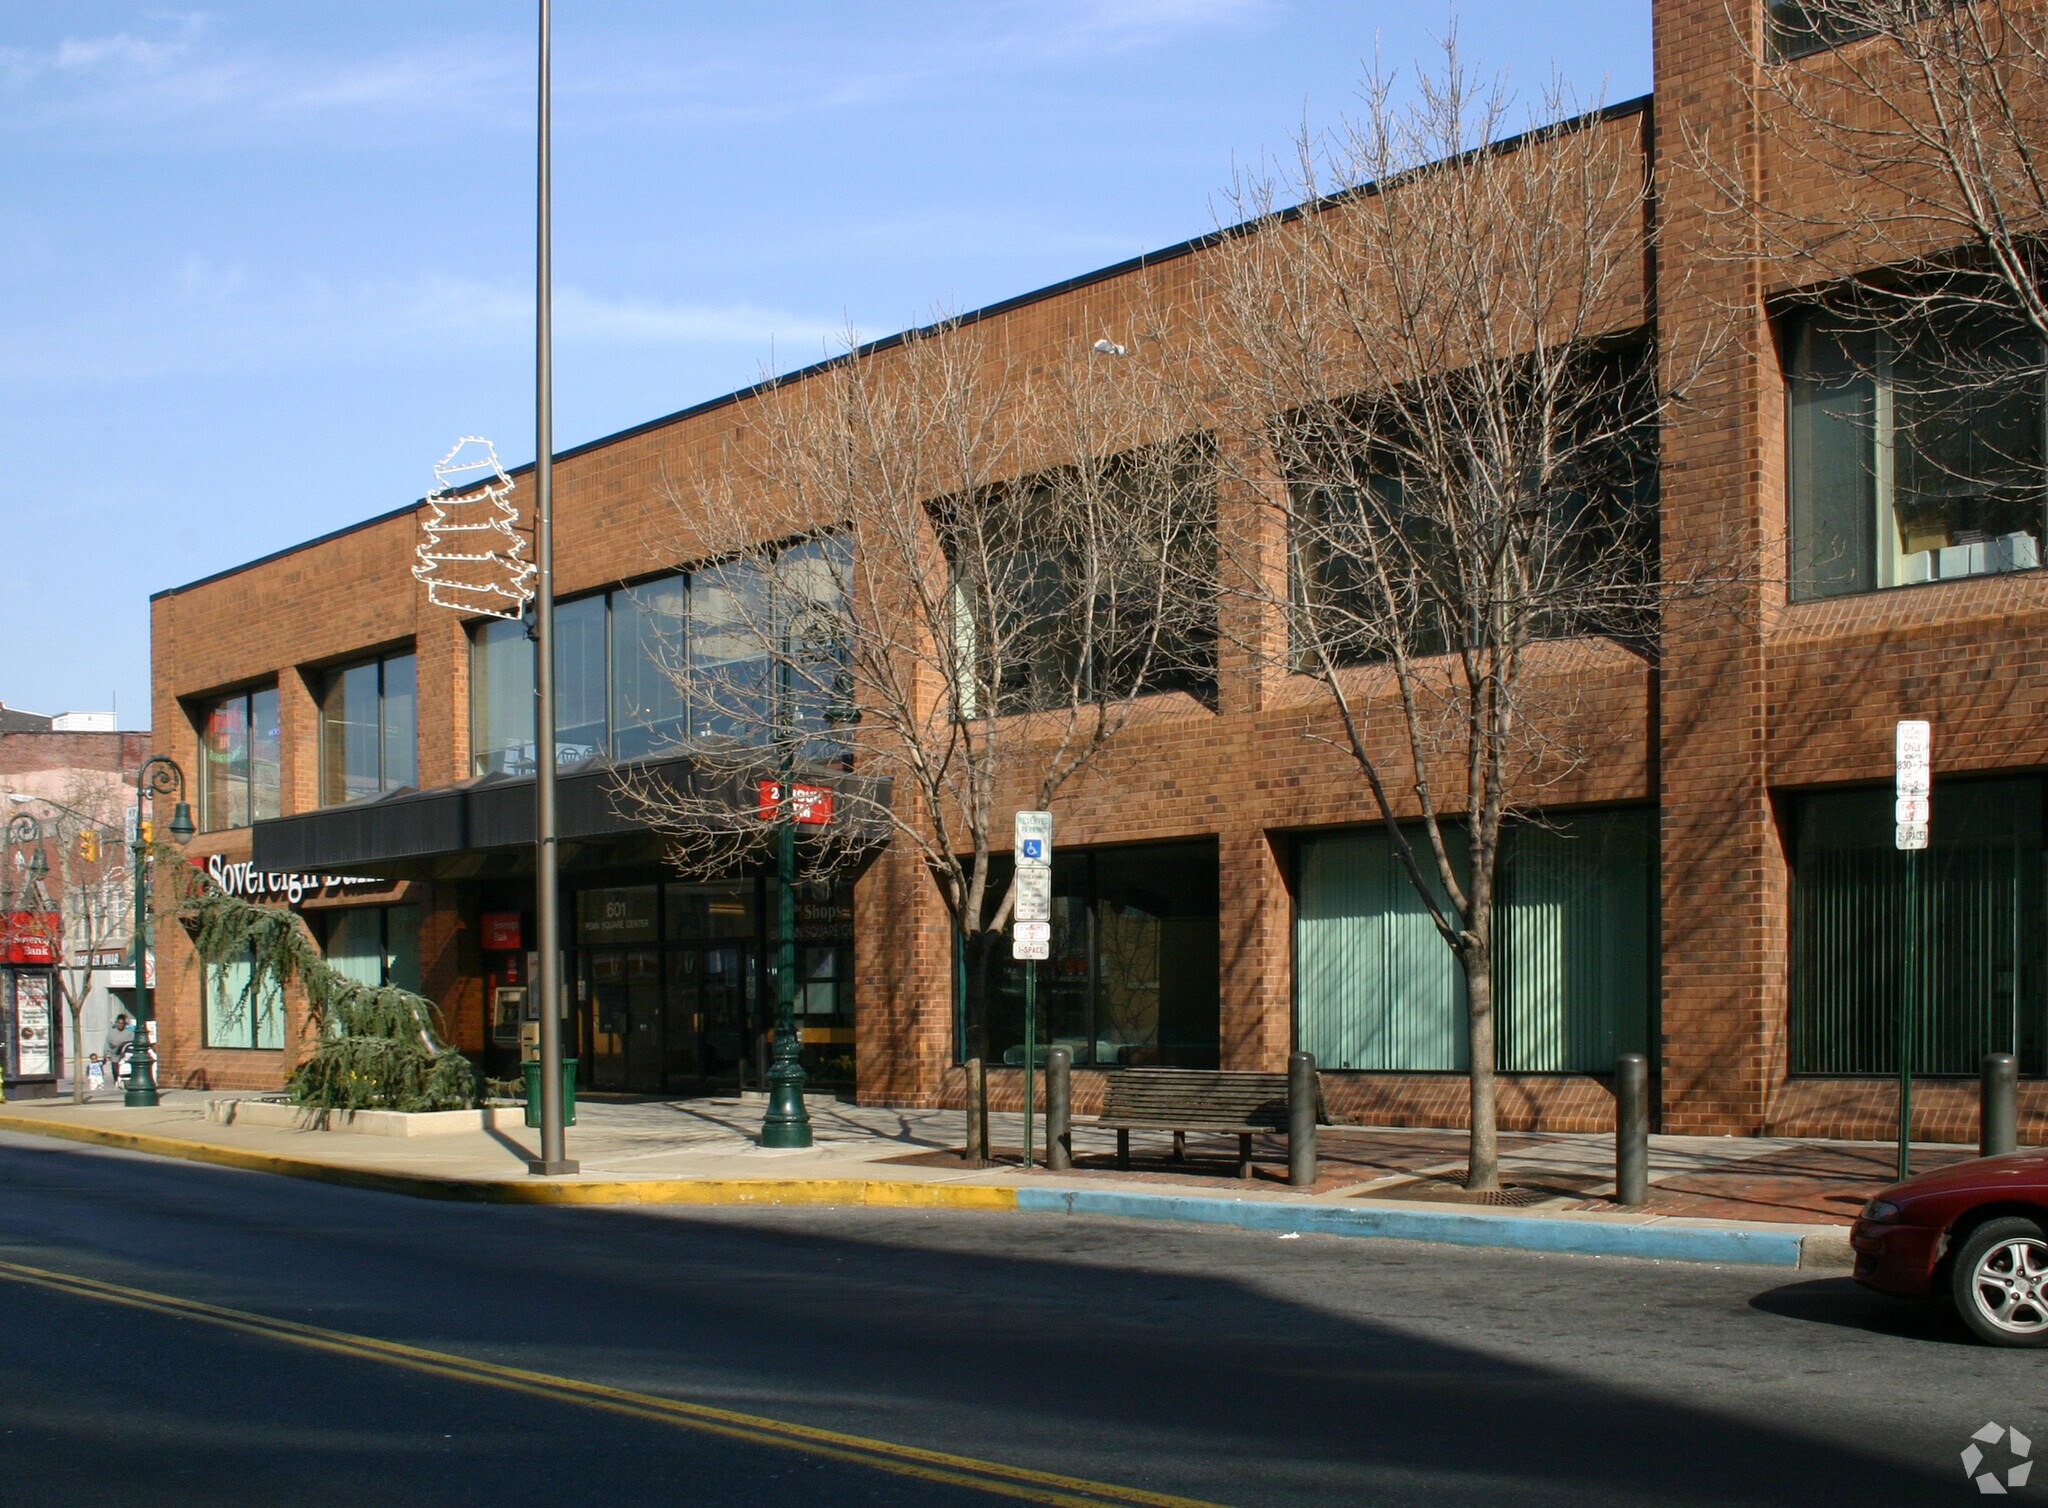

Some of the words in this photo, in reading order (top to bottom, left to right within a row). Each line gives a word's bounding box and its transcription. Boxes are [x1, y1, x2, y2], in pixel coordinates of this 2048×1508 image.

[1903, 742, 1922, 752] ONLY
[1898, 830, 1927, 842] 2-SPACES
[606, 901, 626, 918] 601
[804, 904, 842, 922] Shops
[600, 920, 625, 930] SQUARE
[625, 919, 649, 929] CENTER
[13, 936, 50, 946] Sovereig
[23, 946, 48, 956] Bank
[1018, 945, 1045, 954] 1-SPACE
